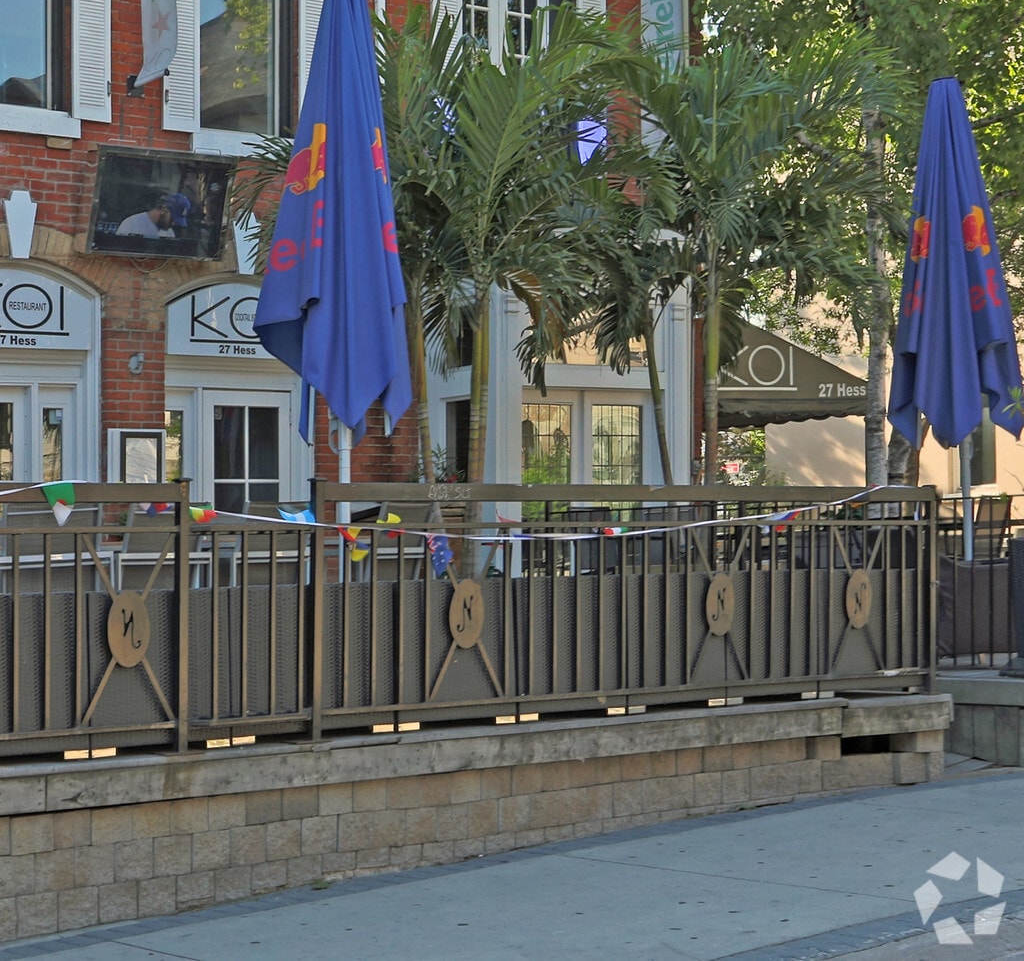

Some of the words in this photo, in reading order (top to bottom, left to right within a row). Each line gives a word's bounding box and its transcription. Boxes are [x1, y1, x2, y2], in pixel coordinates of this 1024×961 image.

[8, 301, 47, 311] RESTAURANT
[191, 294, 259, 339] KO
[10, 336, 36, 345] Hess
[218, 344, 230, 354] 27
[233, 345, 256, 354] Hess
[818, 383, 833, 398] 27
[836, 383, 866, 397] Hess
